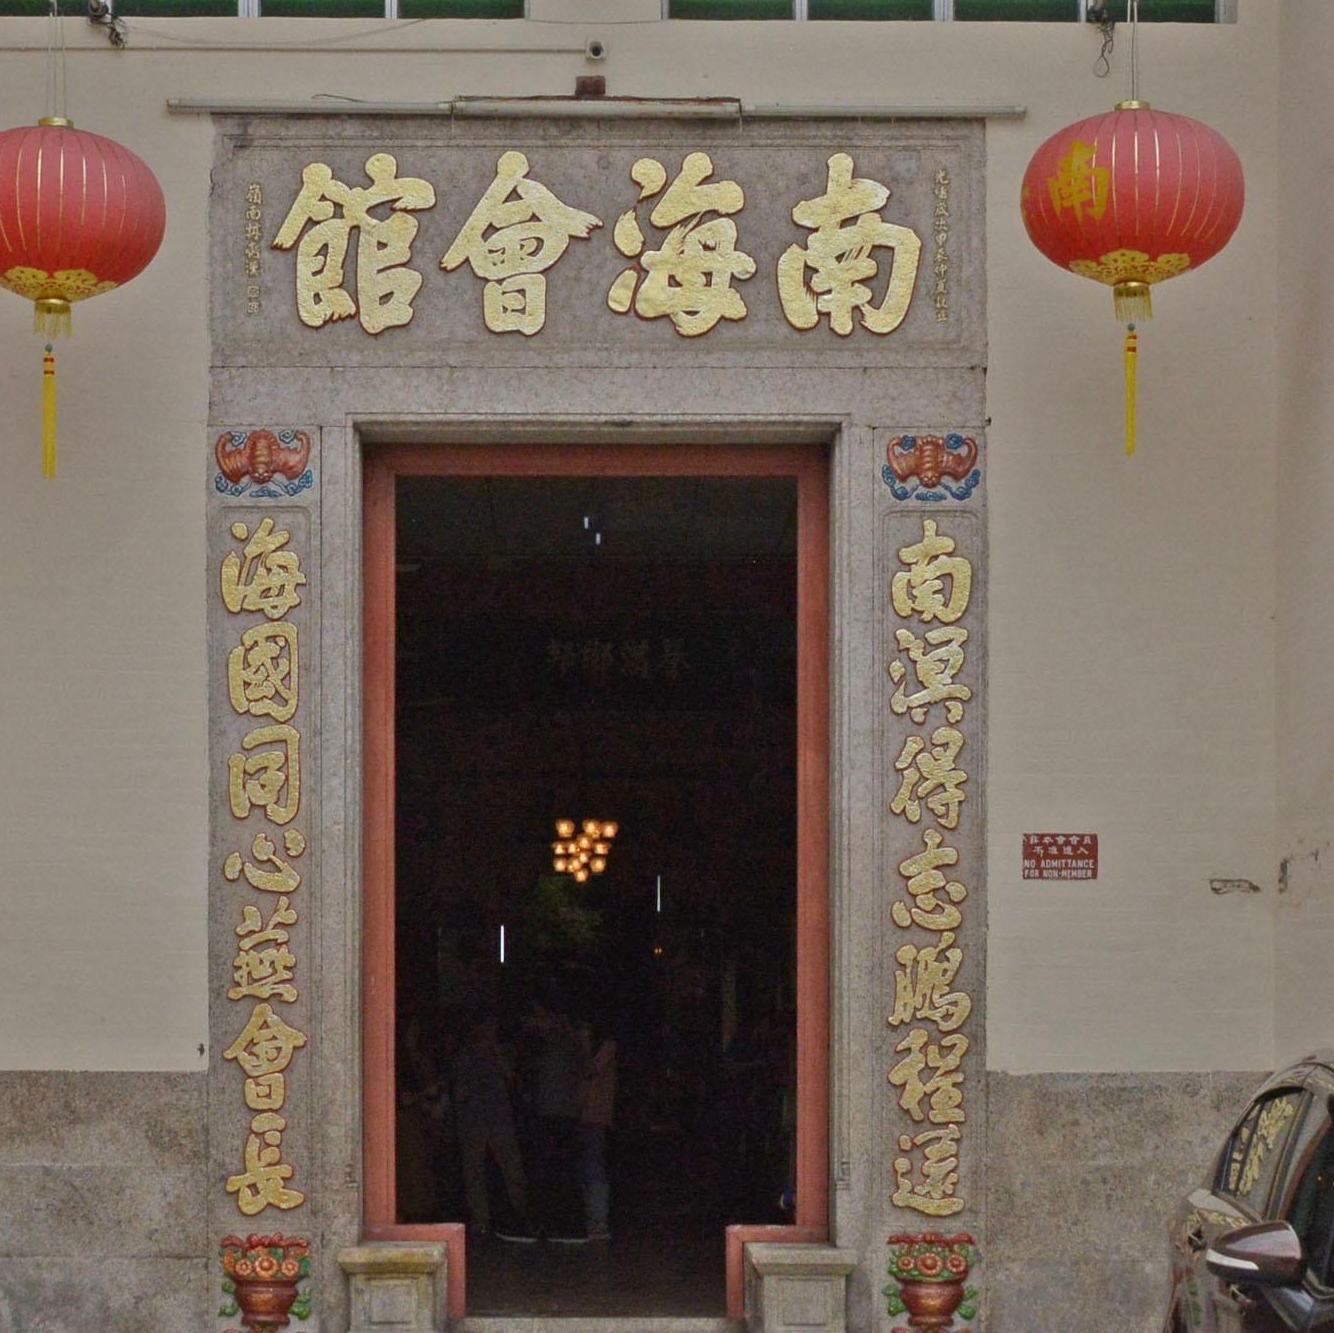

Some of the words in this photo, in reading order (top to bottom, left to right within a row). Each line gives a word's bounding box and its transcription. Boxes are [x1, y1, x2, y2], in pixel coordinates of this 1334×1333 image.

[1049, 140, 1109, 221] 南
[270, 151, 924, 336] 南海會館
[888, 518, 973, 1216] 南溟得志鵬程遠
[1024, 859, 1036, 869] NO
[1040, 859, 1095, 869] ADMITTANCE
[1024, 869, 1039, 878] FOR
